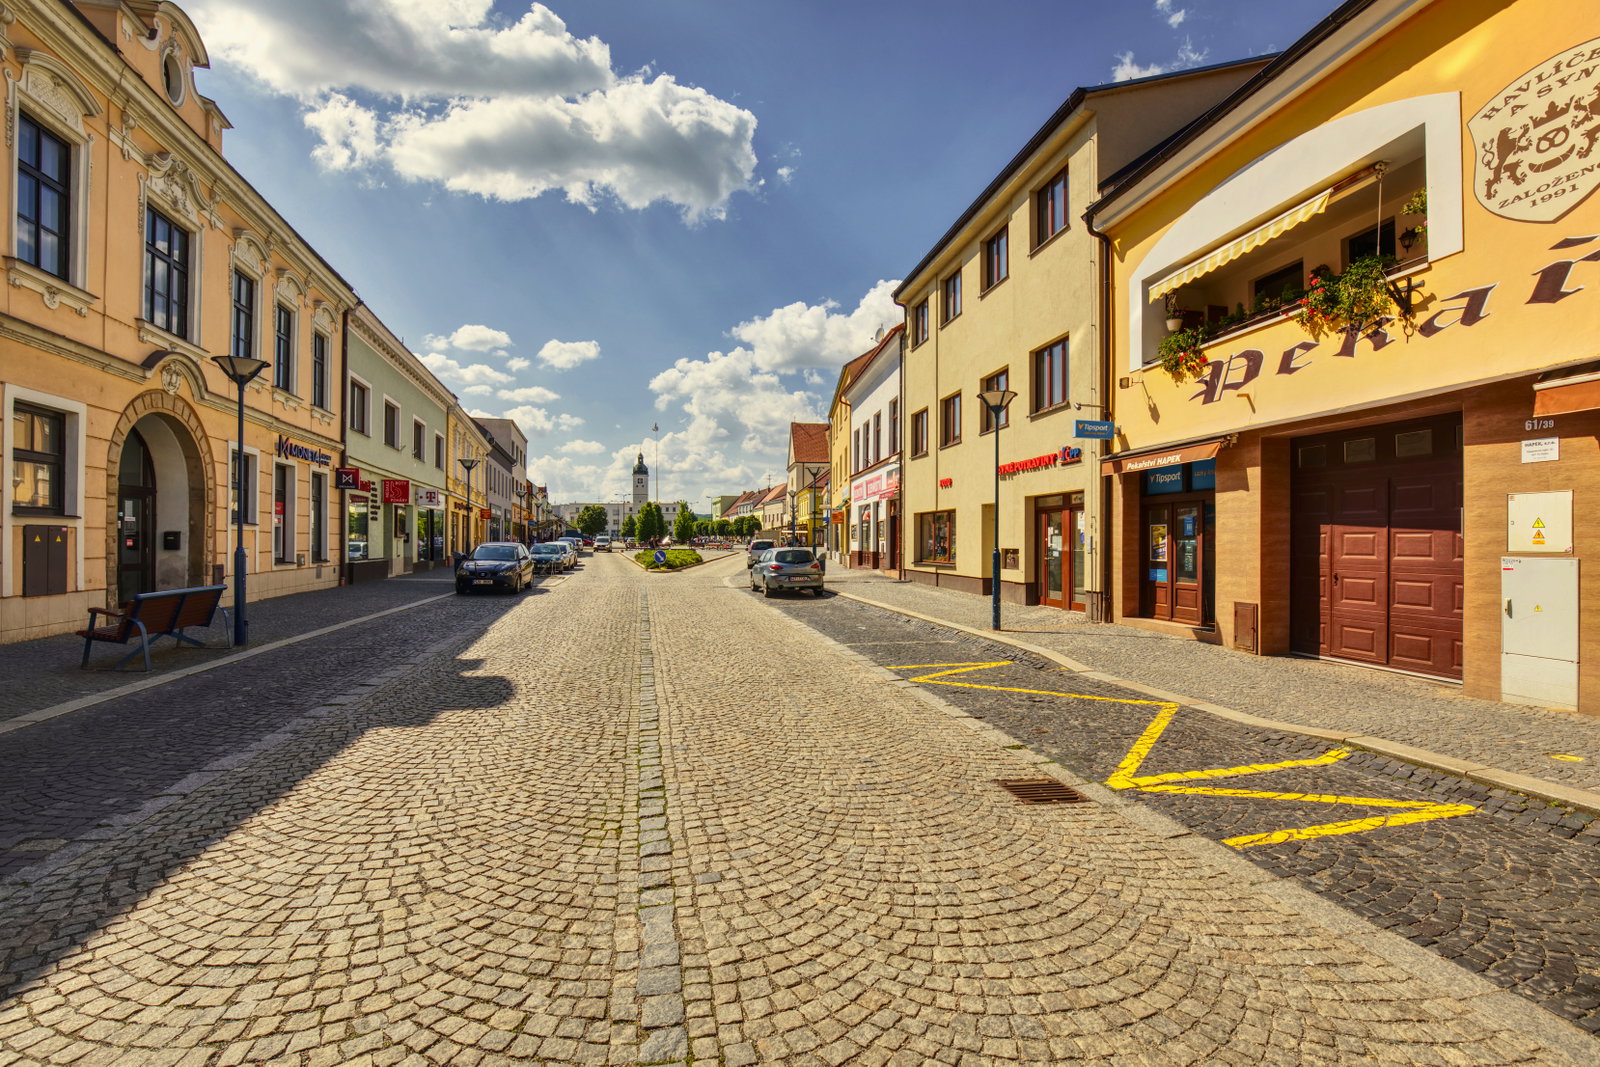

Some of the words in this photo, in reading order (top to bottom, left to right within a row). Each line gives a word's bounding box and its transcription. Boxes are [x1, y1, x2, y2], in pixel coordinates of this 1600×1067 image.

[1511, 104, 1528, 117] A
[1498, 162, 1600, 209] ZALOŽEN
[1530, 184, 1579, 208] 1991
[1525, 419, 1554, 431] 61/39
[1126, 459, 1156, 470] Pekařství
[1156, 454, 1181, 465] HAPEK
[1156, 472, 1181, 483] Tipsport
